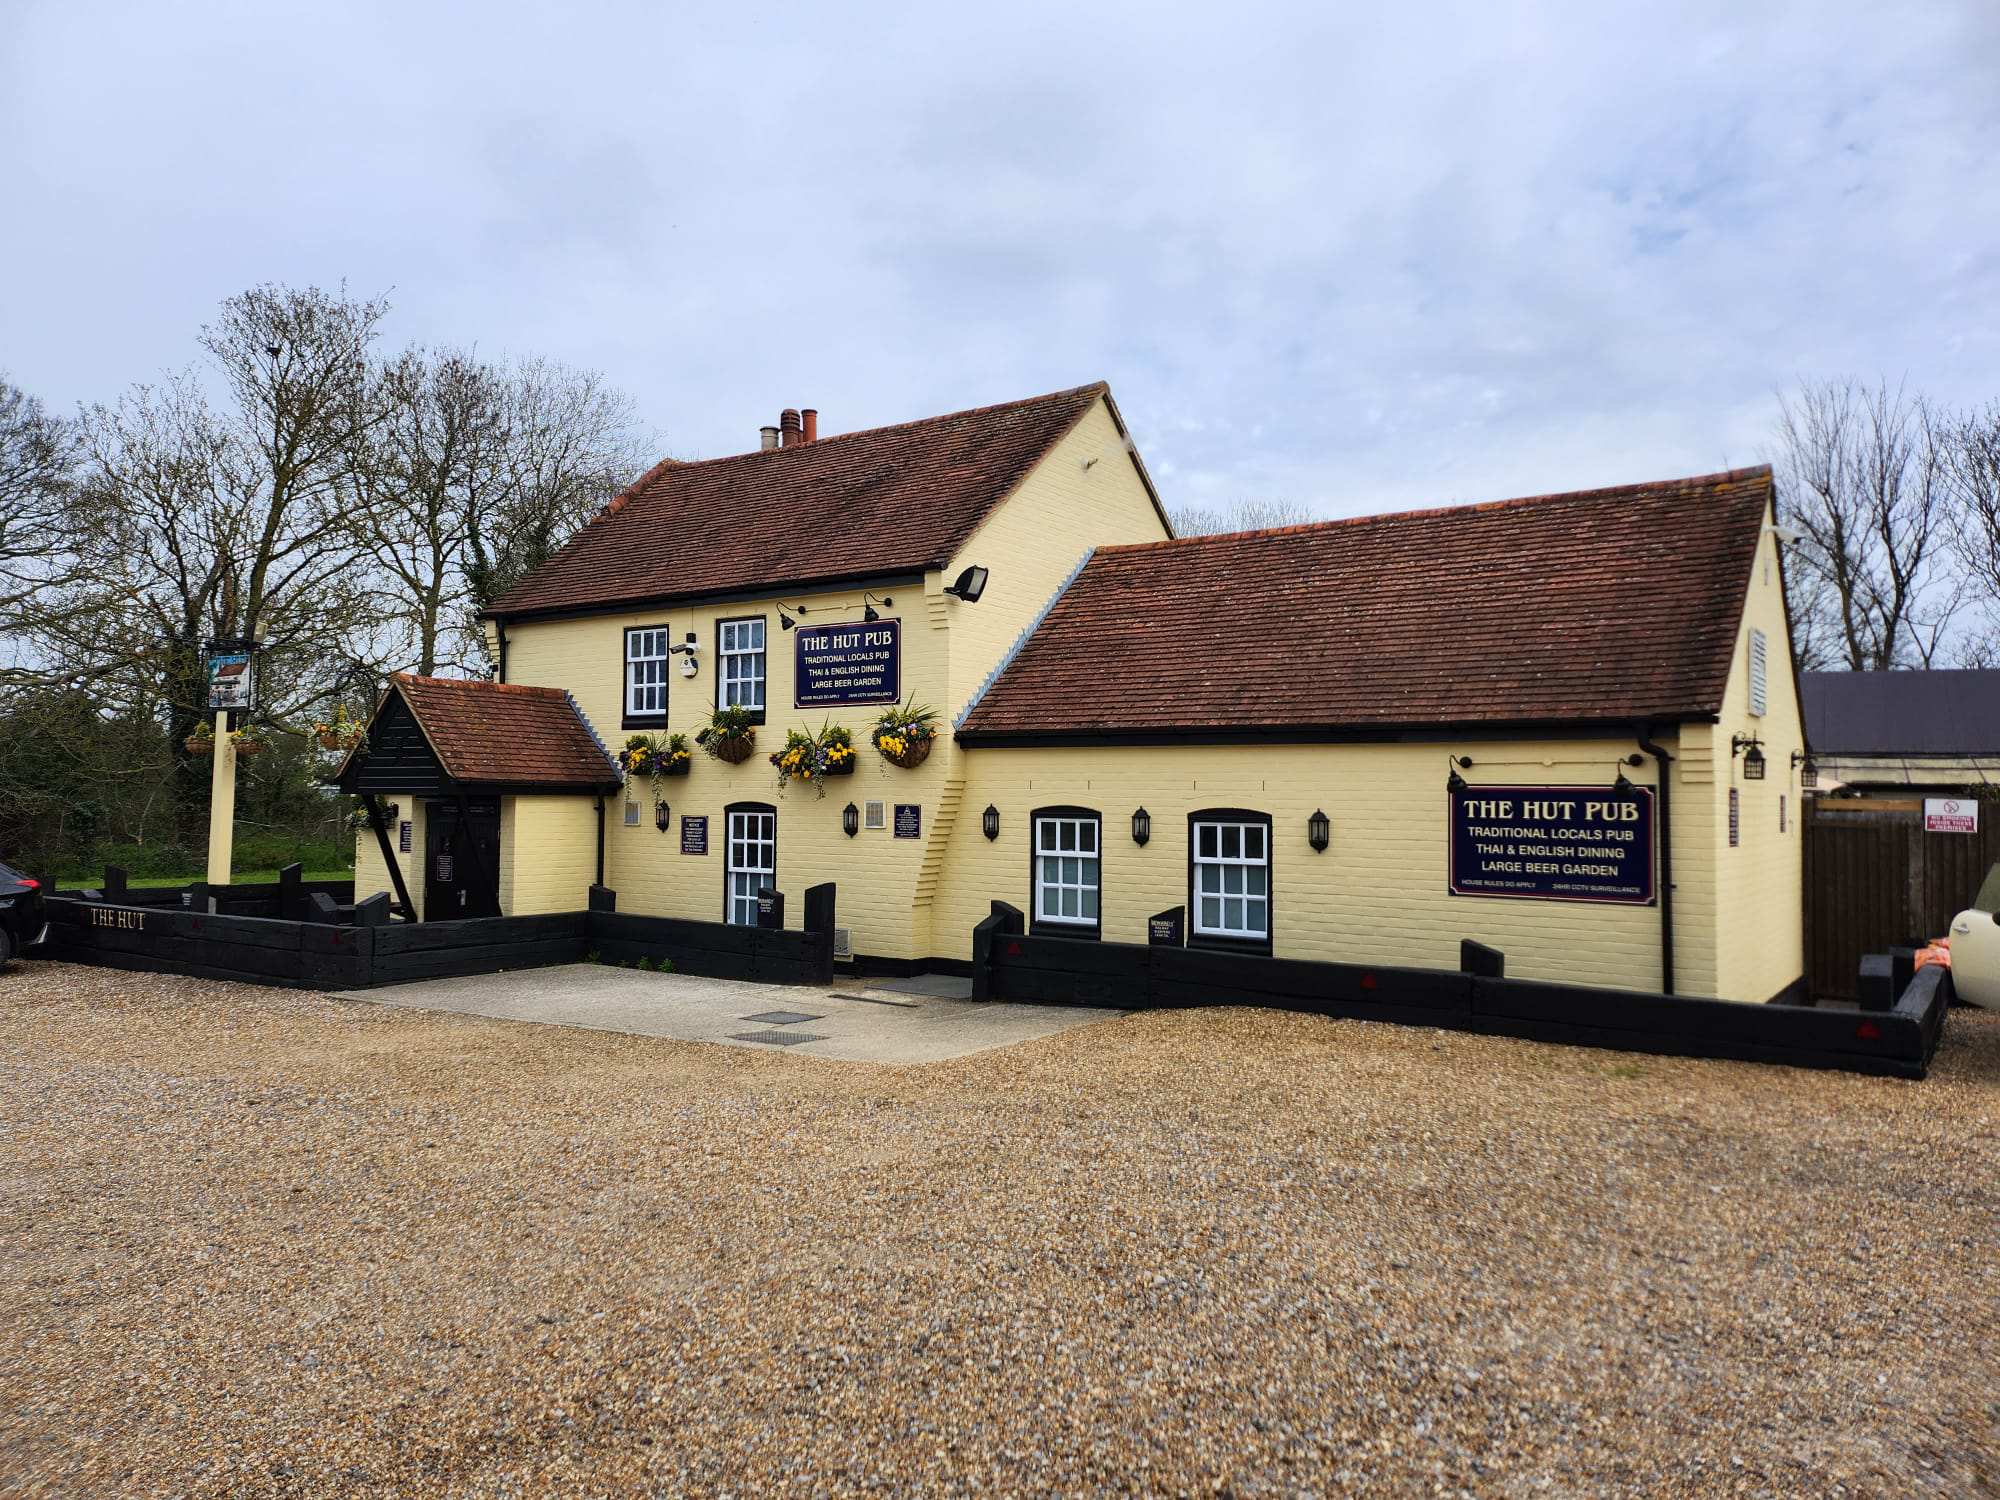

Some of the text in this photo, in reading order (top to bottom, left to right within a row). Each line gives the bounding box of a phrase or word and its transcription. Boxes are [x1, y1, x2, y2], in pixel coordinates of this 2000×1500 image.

[802, 631, 892, 651] THE HUT PUB
[804, 651, 890, 664] TRADITIONAL LOCALS PUB
[808, 664, 885, 677] THAI & ENGLISH DINING
[811, 677, 882, 689] LARGE BEER GARDEN
[1463, 800, 1640, 821] THE HUT PUB
[1467, 826, 1634, 841] TRADITIONAL LOCALS PUB
[1476, 843, 1625, 859] THAI & ENGLISH DINING
[1481, 861, 1619, 876] LARGE BEER GARDEN
[1516, 881, 1537, 889] APPLY
[1590, 885, 1641, 894] SURVEILLANCE
[91, 908, 146, 930] THE HUT
